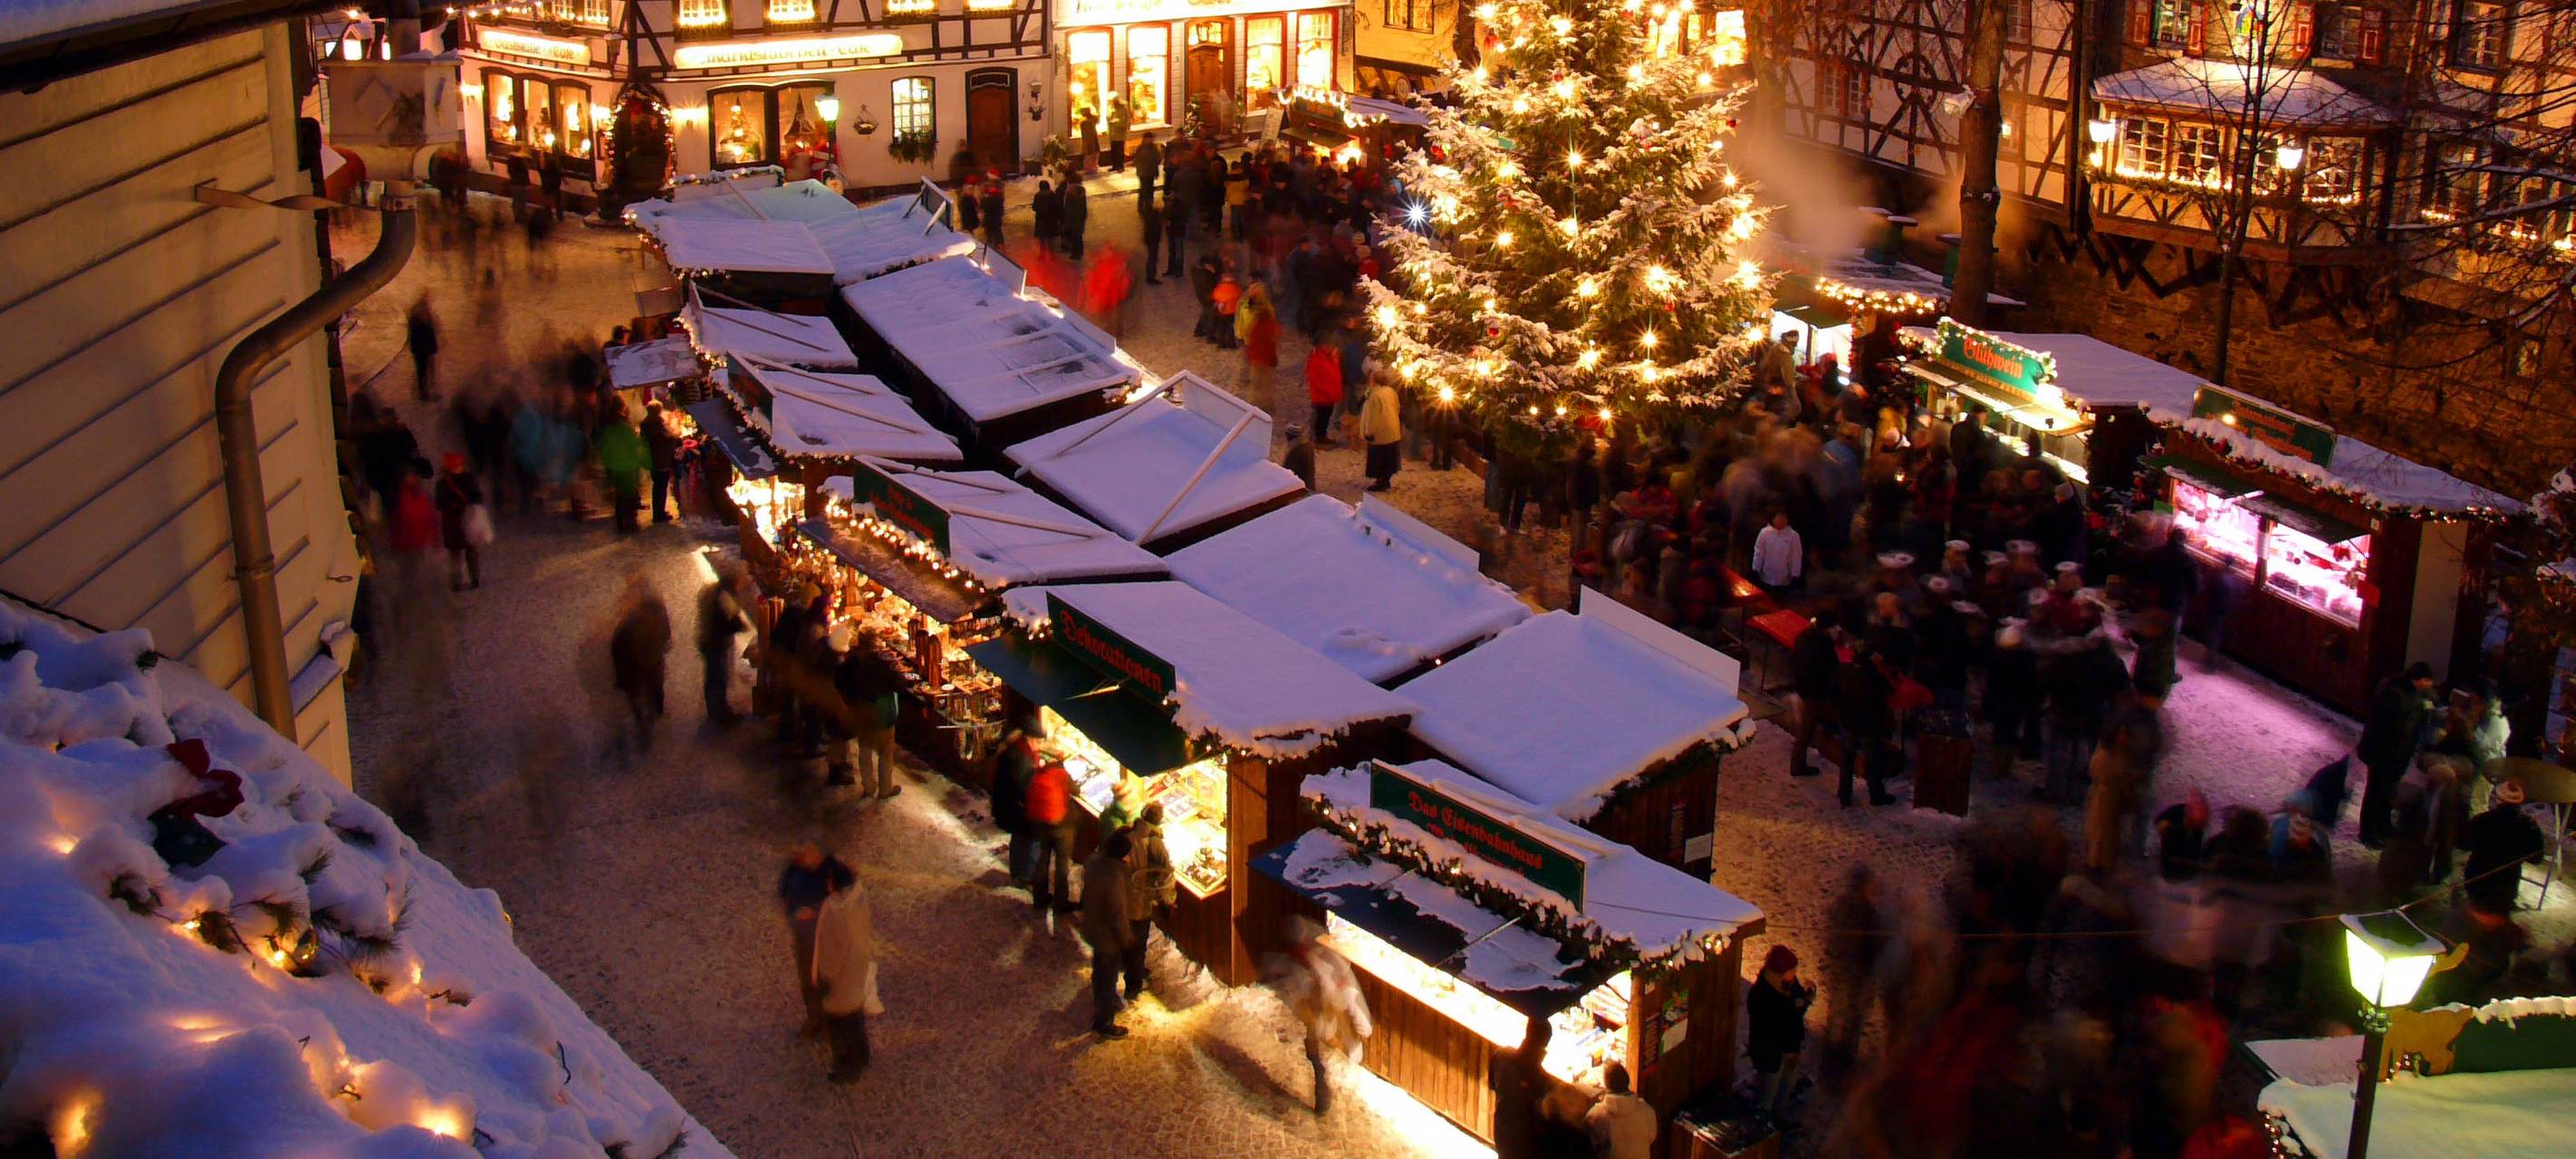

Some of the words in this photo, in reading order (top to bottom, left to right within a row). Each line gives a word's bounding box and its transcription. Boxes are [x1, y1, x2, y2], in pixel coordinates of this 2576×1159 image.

[1060, 608, 1163, 695] Dekorationen
[1409, 791, 1438, 819] Das
[1441, 809, 1543, 869] Eisenbahnhaus
